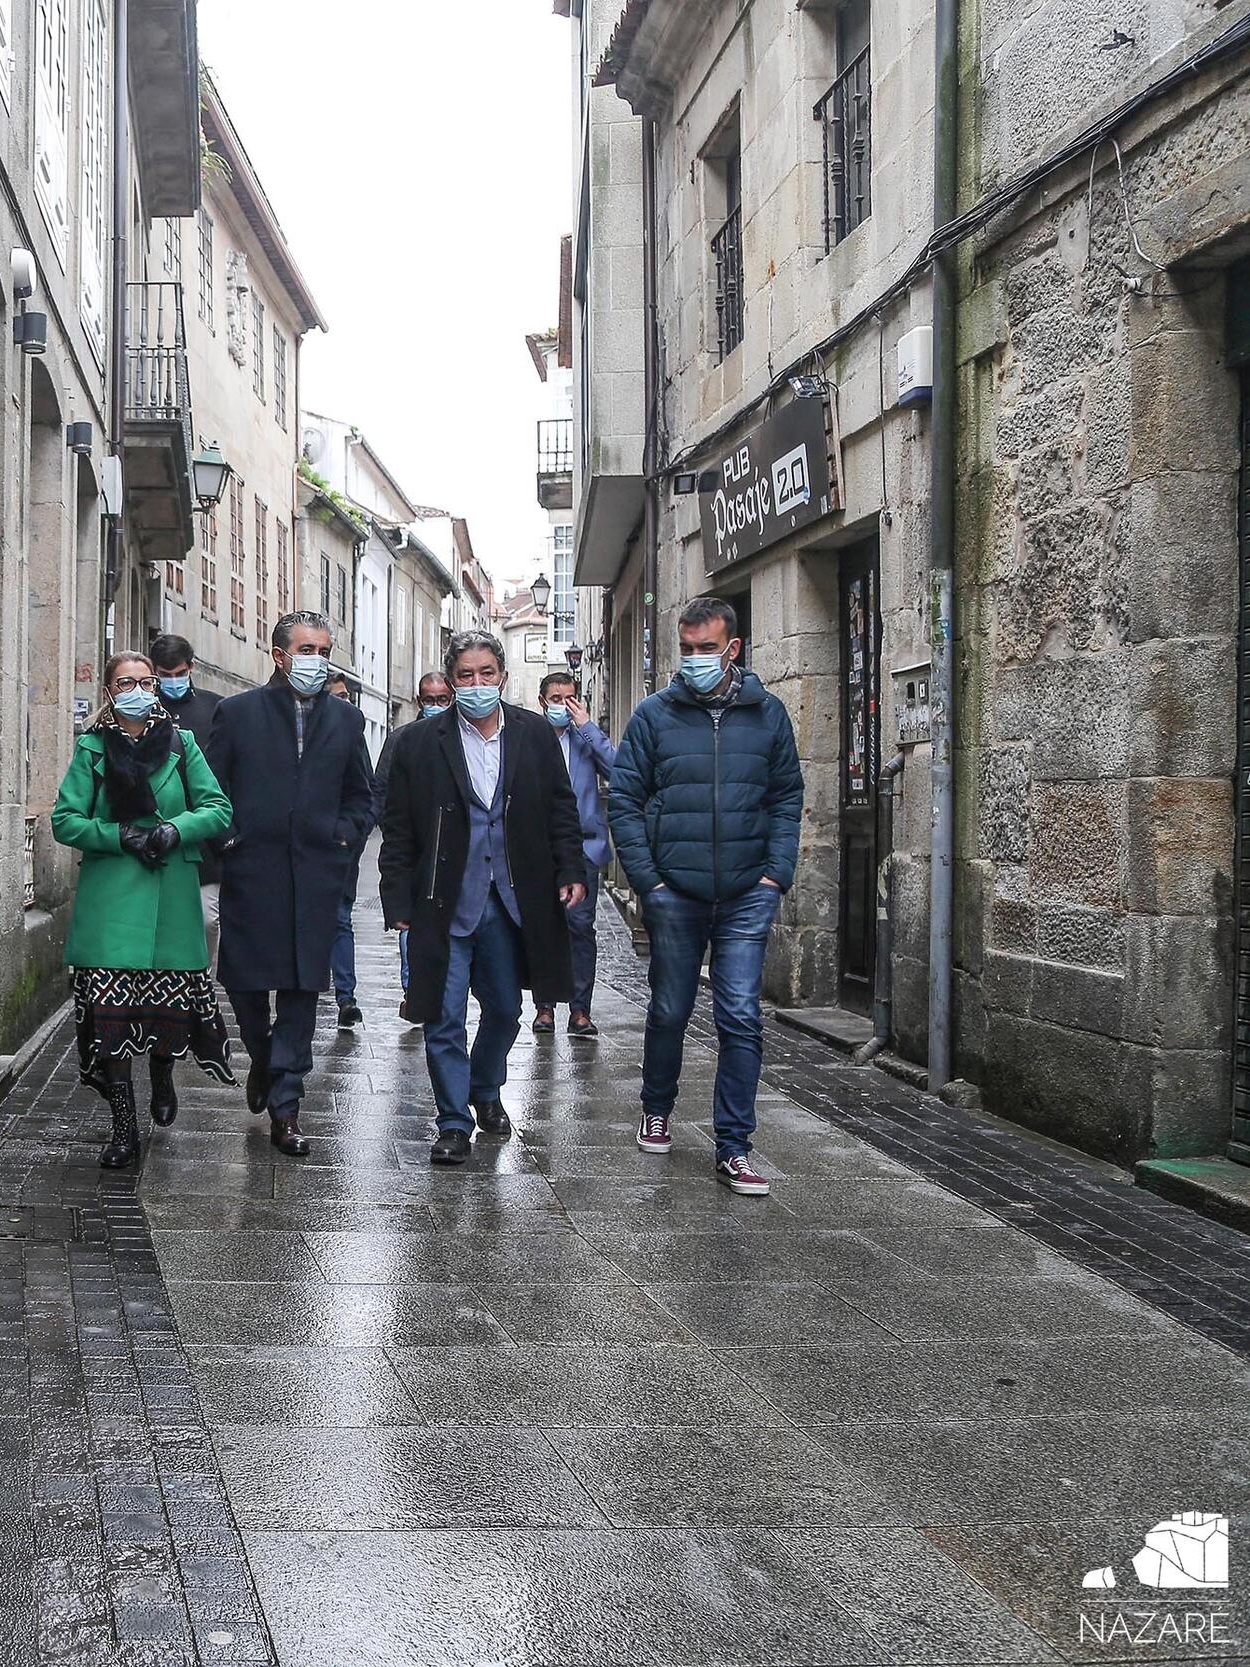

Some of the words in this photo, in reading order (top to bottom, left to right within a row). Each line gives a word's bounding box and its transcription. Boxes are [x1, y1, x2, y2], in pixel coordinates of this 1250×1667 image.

[723, 446, 750, 487] PUB
[711, 466, 770, 556] Pasaje
[777, 457, 806, 504] 2.0
